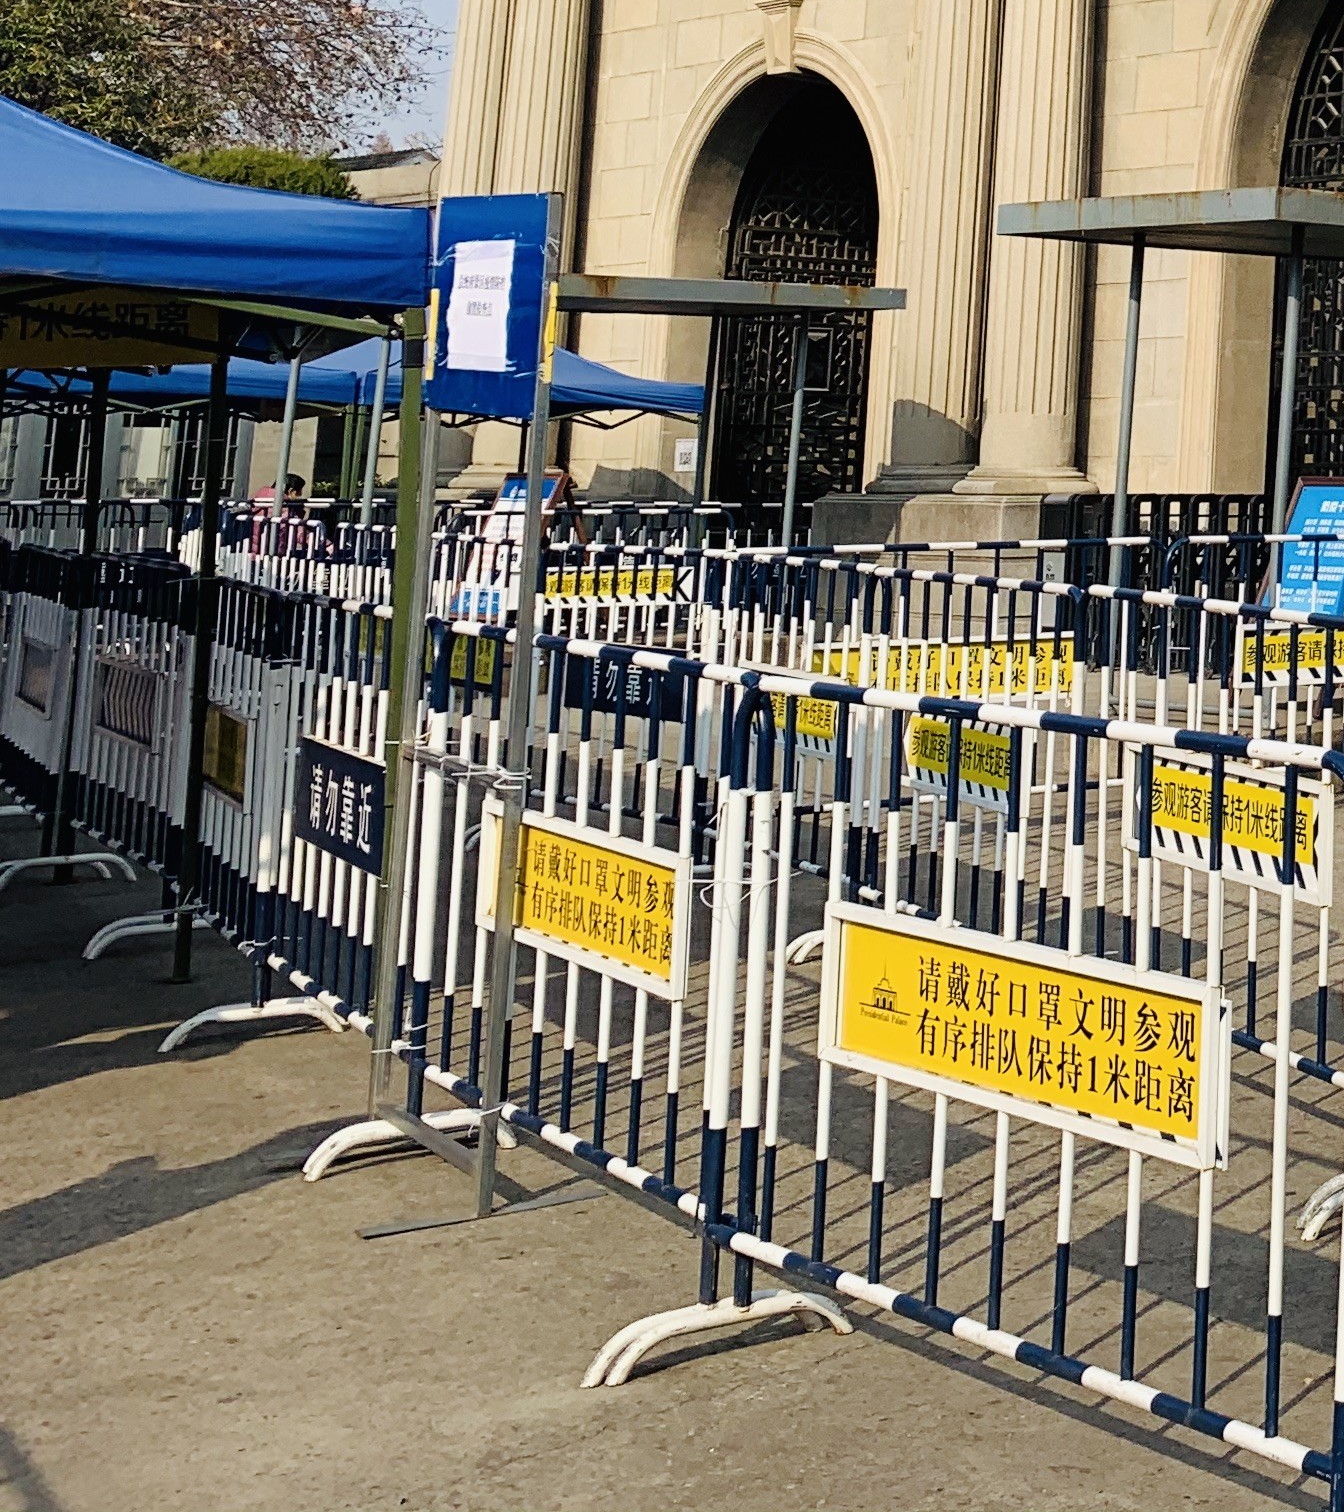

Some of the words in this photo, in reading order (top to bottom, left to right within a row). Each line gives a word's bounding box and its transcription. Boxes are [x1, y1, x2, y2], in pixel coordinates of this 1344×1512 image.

[309, 763, 372, 854] 请勿靠近
[531, 881, 672, 966] 有序排队保持1米距离
[533, 841, 674, 920] 请戴好口罩文明参观
[917, 955, 1197, 1063] 请戴好口罩文明参观
[916, 1007, 1196, 1123] 有序排队保持1米距离
